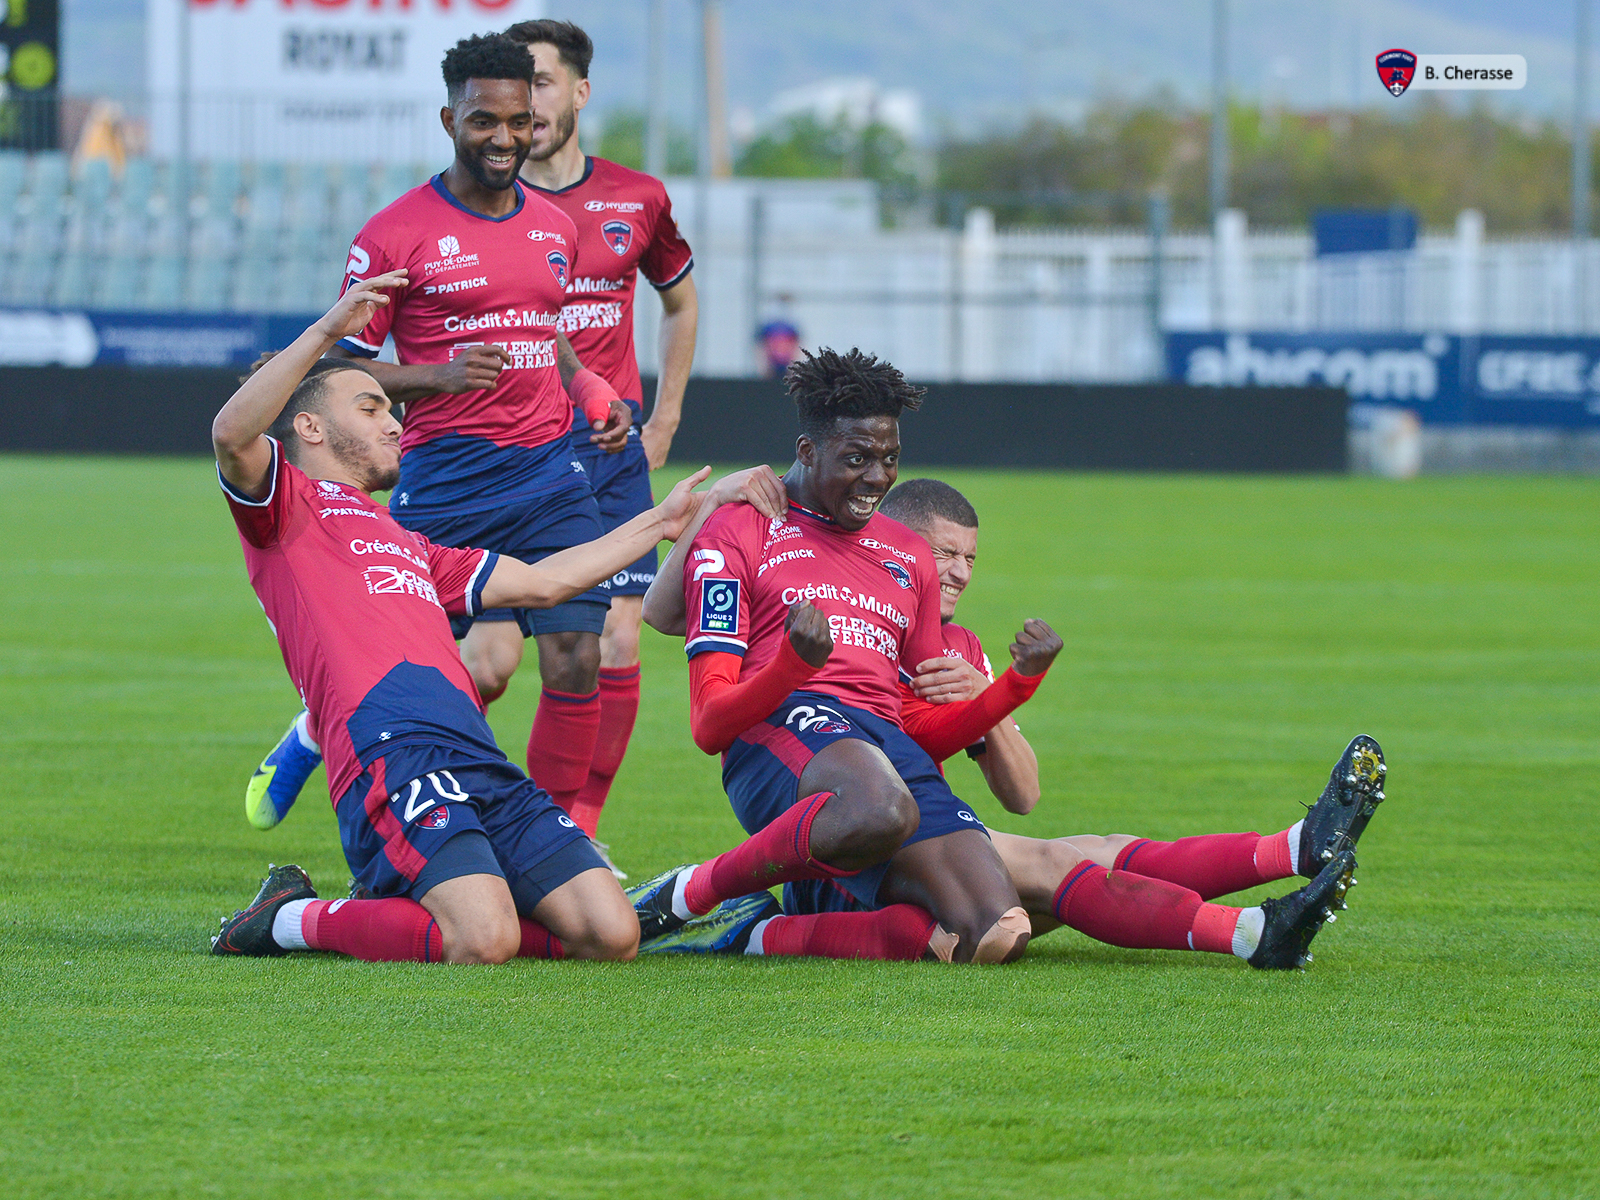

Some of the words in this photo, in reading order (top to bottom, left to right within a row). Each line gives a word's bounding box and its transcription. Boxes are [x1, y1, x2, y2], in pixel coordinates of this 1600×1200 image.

[606, 202, 644, 211] HYUNDAI
[424, 253, 479, 271] PUY-DE-DÔME
[438, 276, 489, 295] PATRICK
[444, 311, 503, 332] Crédit
[522, 309, 558, 327] Mutue
[331, 508, 379, 520] PATRICK
[350, 538, 403, 557] Crédit
[768, 548, 816, 568] PATRICK
[781, 582, 840, 606] Crédit
[858, 593, 910, 630] Mutuel
[706, 612, 727, 621] LIGUE
[708, 620, 730, 629] BKT
[403, 769, 470, 823] 20
